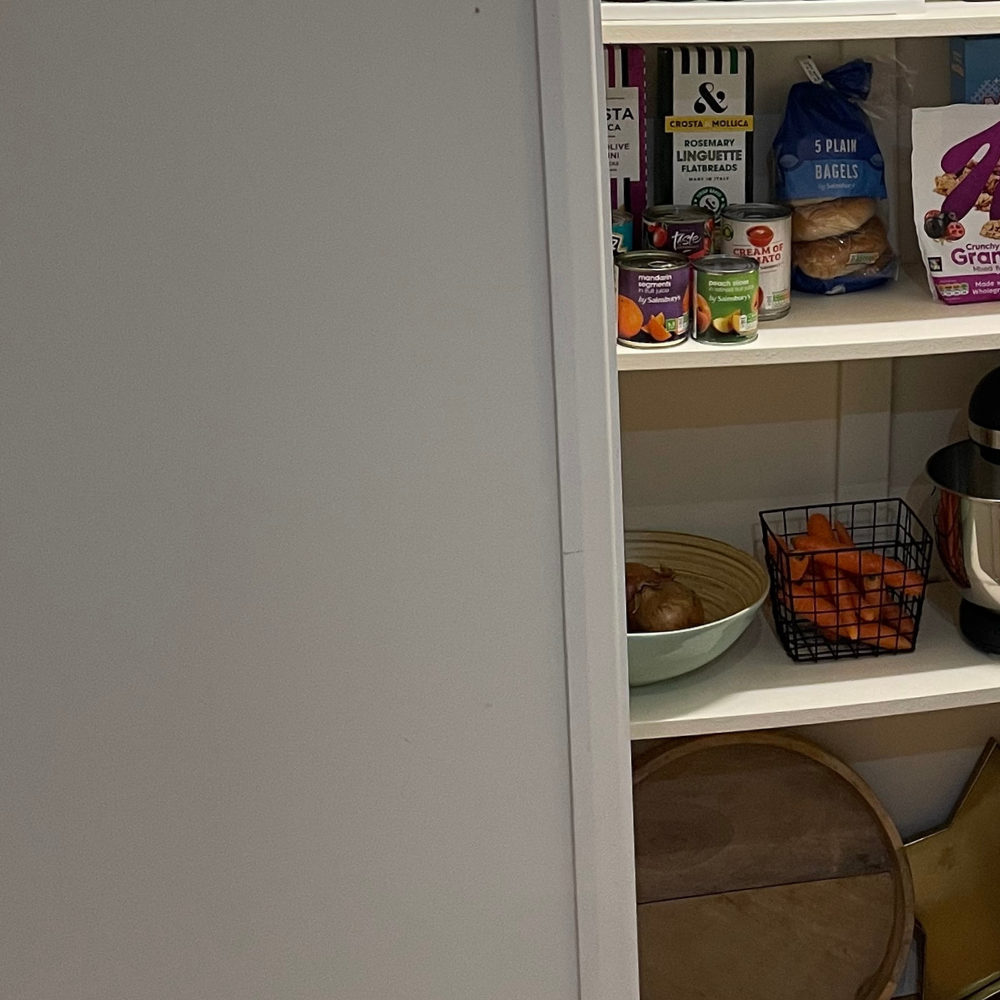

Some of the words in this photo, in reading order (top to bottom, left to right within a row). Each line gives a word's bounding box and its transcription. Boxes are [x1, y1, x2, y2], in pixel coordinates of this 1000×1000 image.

[669, 120, 704, 128] CROSTA
[711, 119, 749, 127] MOLLICA
[608, 142, 630, 151] LIVE
[684, 138, 736, 148] ROSEMARY
[814, 139, 822, 153] 5
[825, 138, 858, 153] PLAIN
[676, 150, 743, 162] LINGUETTE
[681, 163, 738, 173] FLATBREADS
[815, 163, 859, 180] BAGELS
[732, 243, 771, 257] CREAM
[772, 242, 784, 253] OF
[965, 242, 1000, 251] Crunchy
[972, 264, 994, 272] Mixed
[638, 274, 673, 282] mandarin
[638, 281, 672, 289] segments
[708, 280, 732, 289] peach
[732, 279, 750, 287] slices
[974, 280, 995, 288] Made
[638, 296, 648, 305] by
[647, 294, 682, 304] Sainsbury's
[708, 294, 718, 303] by
[717, 294, 752, 303] Sainsbury's
